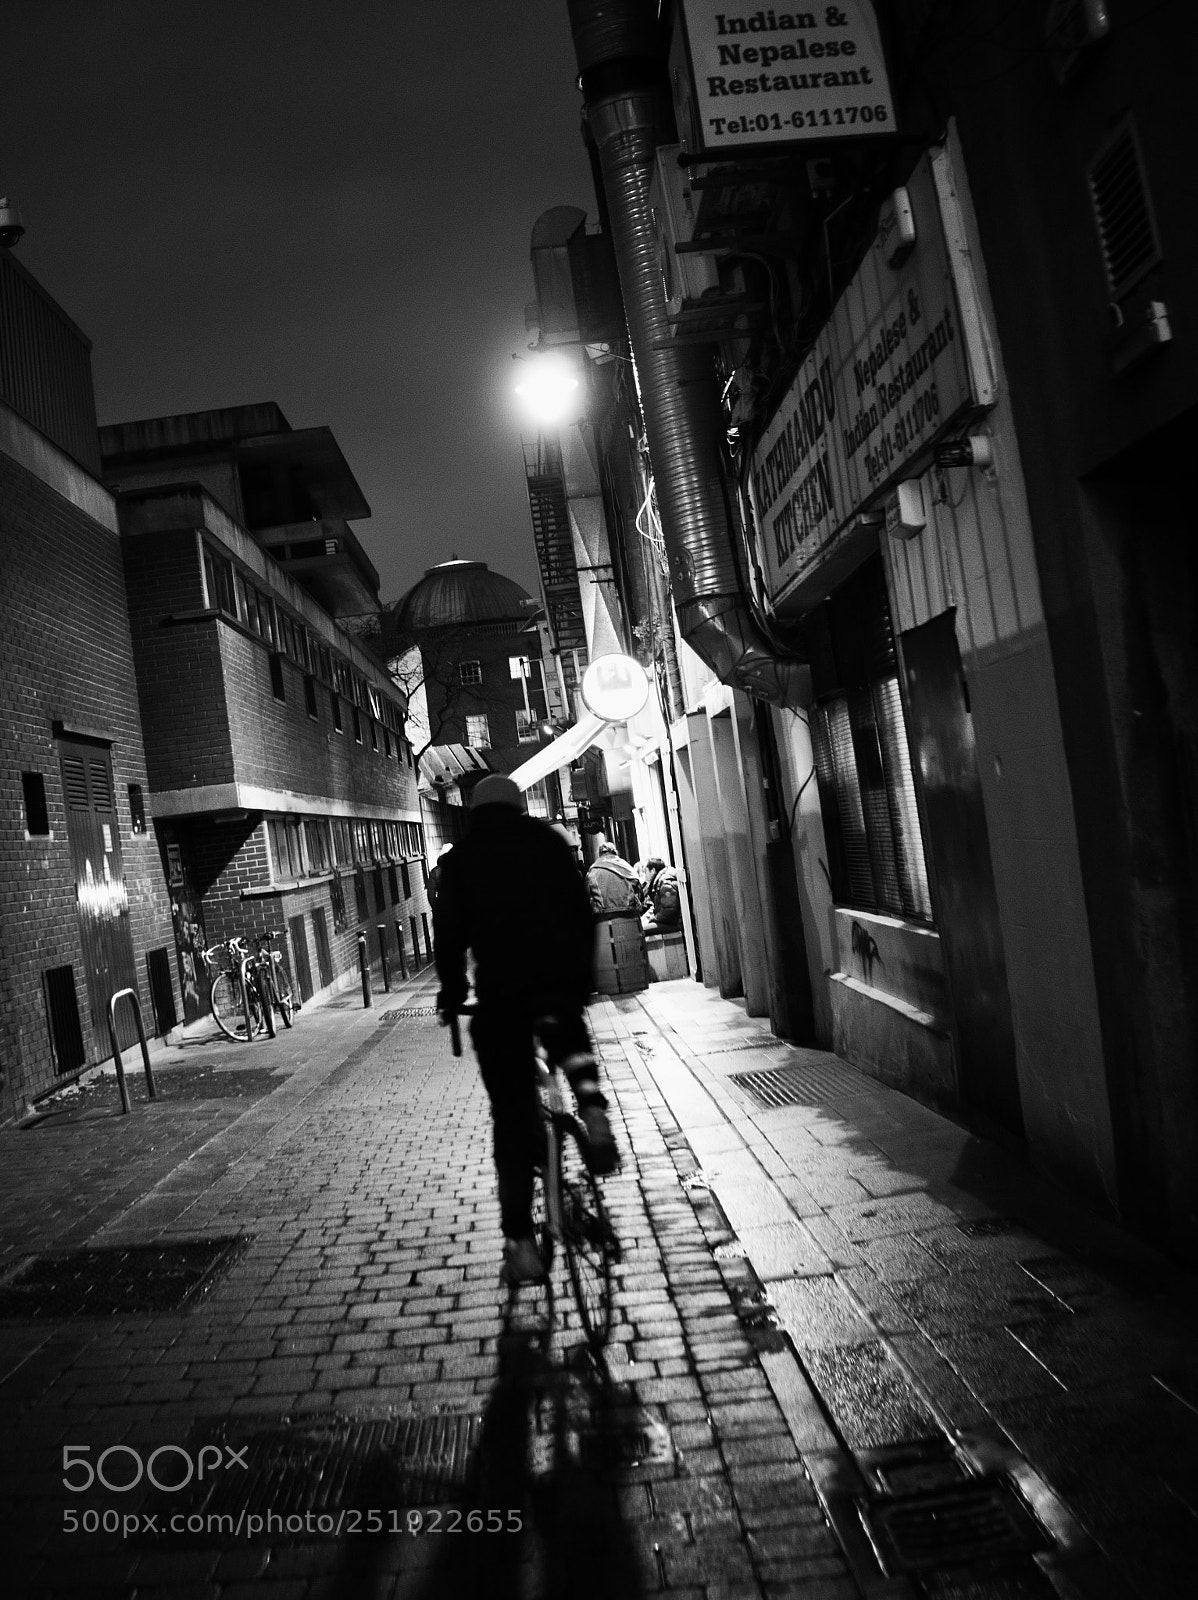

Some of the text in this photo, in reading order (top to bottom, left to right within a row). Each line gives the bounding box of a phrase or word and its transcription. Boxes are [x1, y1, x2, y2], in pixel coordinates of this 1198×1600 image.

[715, 6, 848, 35] Indian &
[717, 38, 857, 67] Nepalese
[706, 66, 874, 97] Restaurant
[709, 105, 888, 136] Tel:01-6111706
[854, 287, 920, 397] Nepalese &
[843, 304, 954, 460] Indian Restaurant
[773, 450, 835, 568] KITCHEN
